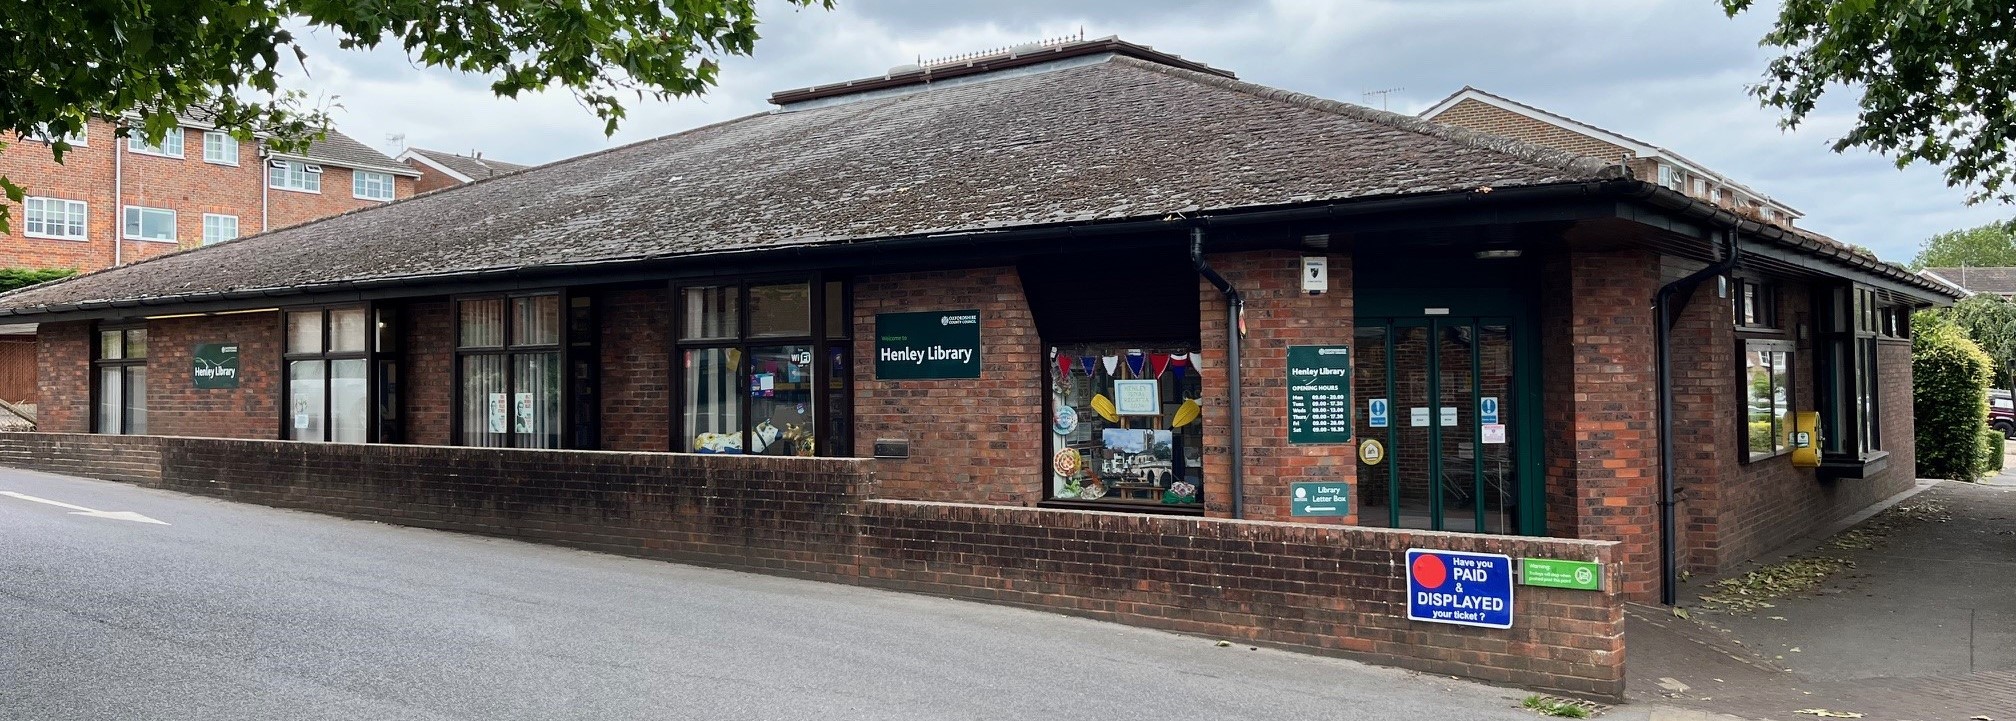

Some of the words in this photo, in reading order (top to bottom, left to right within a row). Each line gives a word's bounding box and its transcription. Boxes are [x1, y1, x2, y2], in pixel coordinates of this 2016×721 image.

[881, 346, 925, 364] Henley
[928, 345, 972, 364] Library
[195, 367, 214, 379] Henley
[215, 366, 235, 378] Library
[1292, 368, 1318, 376] Henley
[1320, 368, 1345, 376] Library
[1318, 486, 1340, 494] Library
[1453, 557, 1475, 567] Have
[1453, 568, 1487, 582] PAID
[1455, 582, 1463, 593] &
[1417, 592, 1504, 611] DISPLAYED
[1433, 610, 1452, 618] your
[1454, 611, 1478, 620] ticket
[1479, 612, 1485, 621] ?
